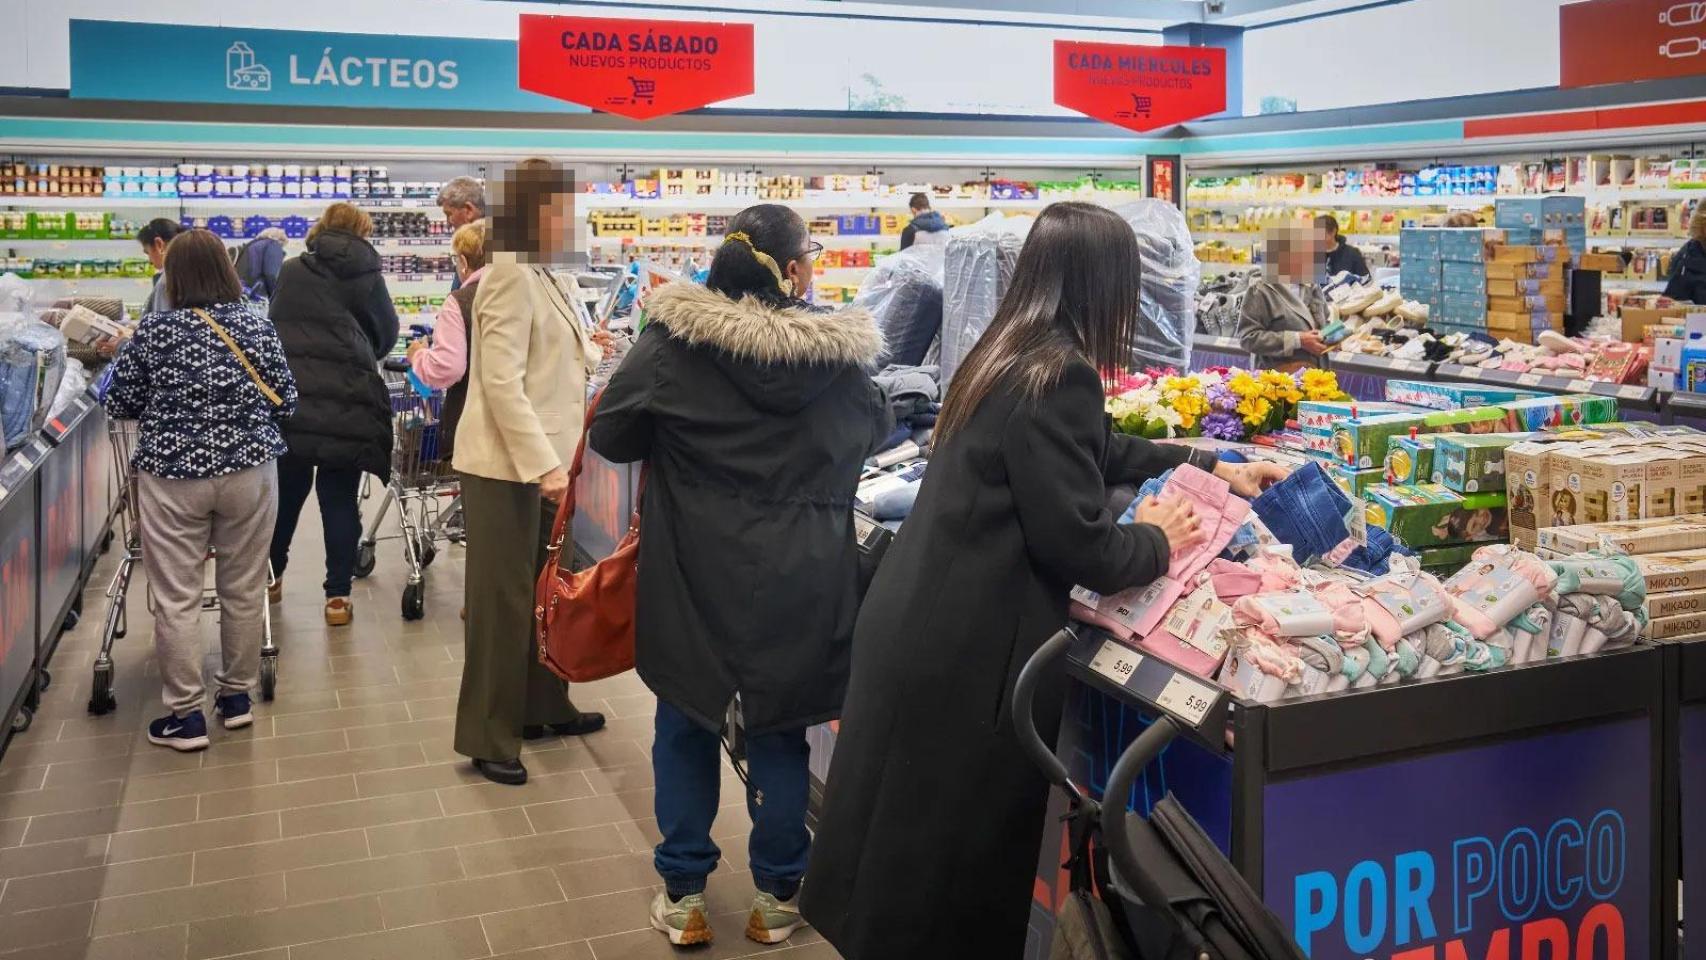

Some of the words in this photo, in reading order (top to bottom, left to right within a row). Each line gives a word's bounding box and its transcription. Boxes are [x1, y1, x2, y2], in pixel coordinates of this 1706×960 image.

[561, 31, 622, 51] CADA
[627, 29, 719, 55] SÁBADO
[289, 47, 459, 89] LÁCTEOS
[569, 54, 626, 68] NUEVOS
[629, 54, 712, 71] PRODUCTOS
[1068, 53, 1113, 70] CADA
[1132, 73, 1192, 90] PRODUCTOS
[1650, 576, 1689, 590] MIKADO
[1660, 599, 1698, 614] MIKADO
[1663, 619, 1701, 635] MIKADO
[1113, 659, 1133, 675] 5,99
[1185, 695, 1208, 712] 5,99
[1294, 850, 1438, 959] POR
[1453, 809, 1626, 934] POCO
